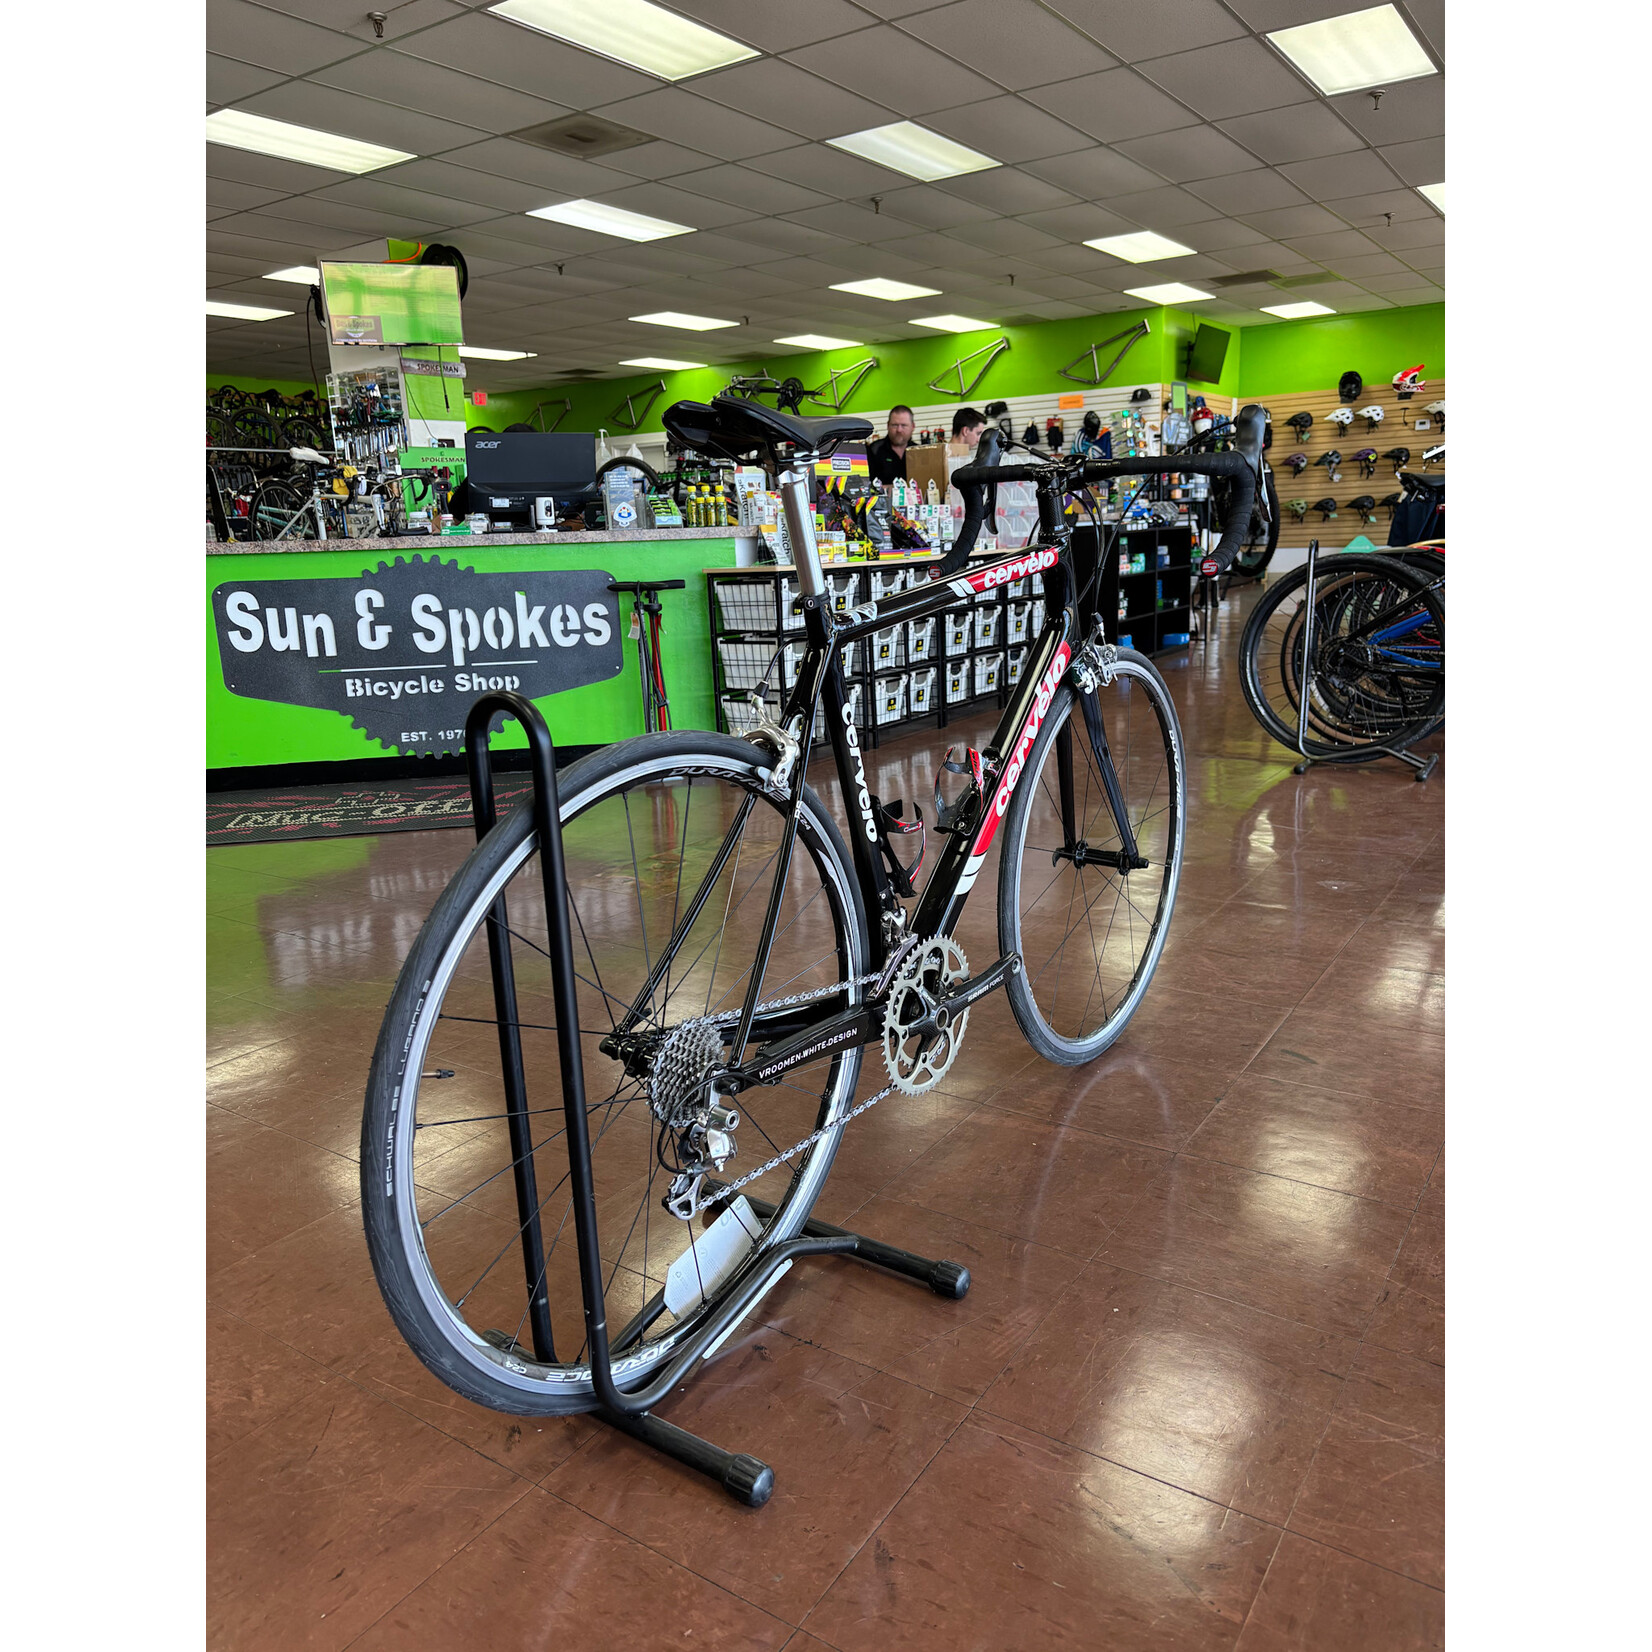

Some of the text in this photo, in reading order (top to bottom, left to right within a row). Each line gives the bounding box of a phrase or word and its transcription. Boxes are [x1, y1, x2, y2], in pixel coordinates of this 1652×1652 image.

[475, 441, 501, 449] acer
[225, 589, 612, 666] Sun & Spokes
[345, 673, 521, 699] Bicycle Shop
[401, 729, 467, 742] EST. 197
[386, 998, 424, 1197] SCHWALBE LUGANO
